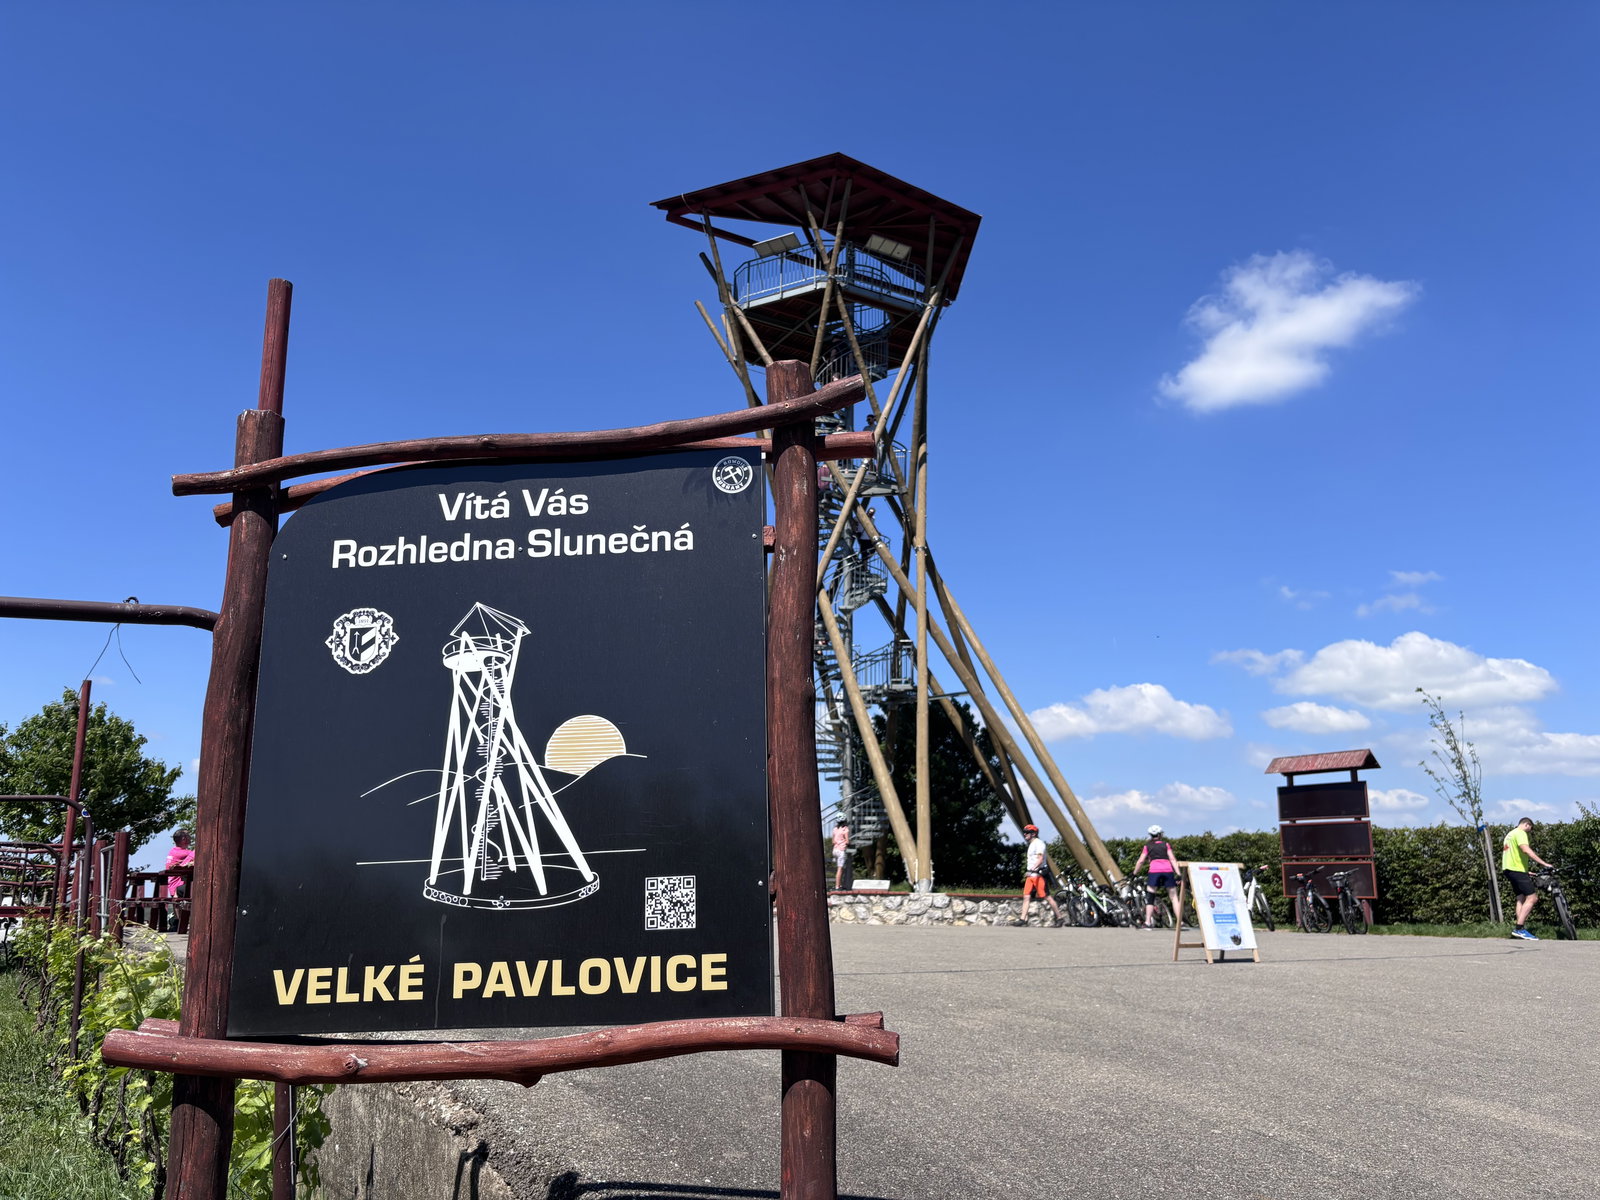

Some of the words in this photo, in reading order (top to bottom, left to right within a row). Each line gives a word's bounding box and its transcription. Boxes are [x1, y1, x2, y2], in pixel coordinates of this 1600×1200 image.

[439, 491, 510, 521] Vítá
[522, 488, 588, 516] Vás
[332, 533, 514, 568] Rozhledna
[528, 522, 693, 557] Slunečná
[273, 955, 424, 1005] VELKÉ
[453, 954, 727, 998] PAVLOVICE
